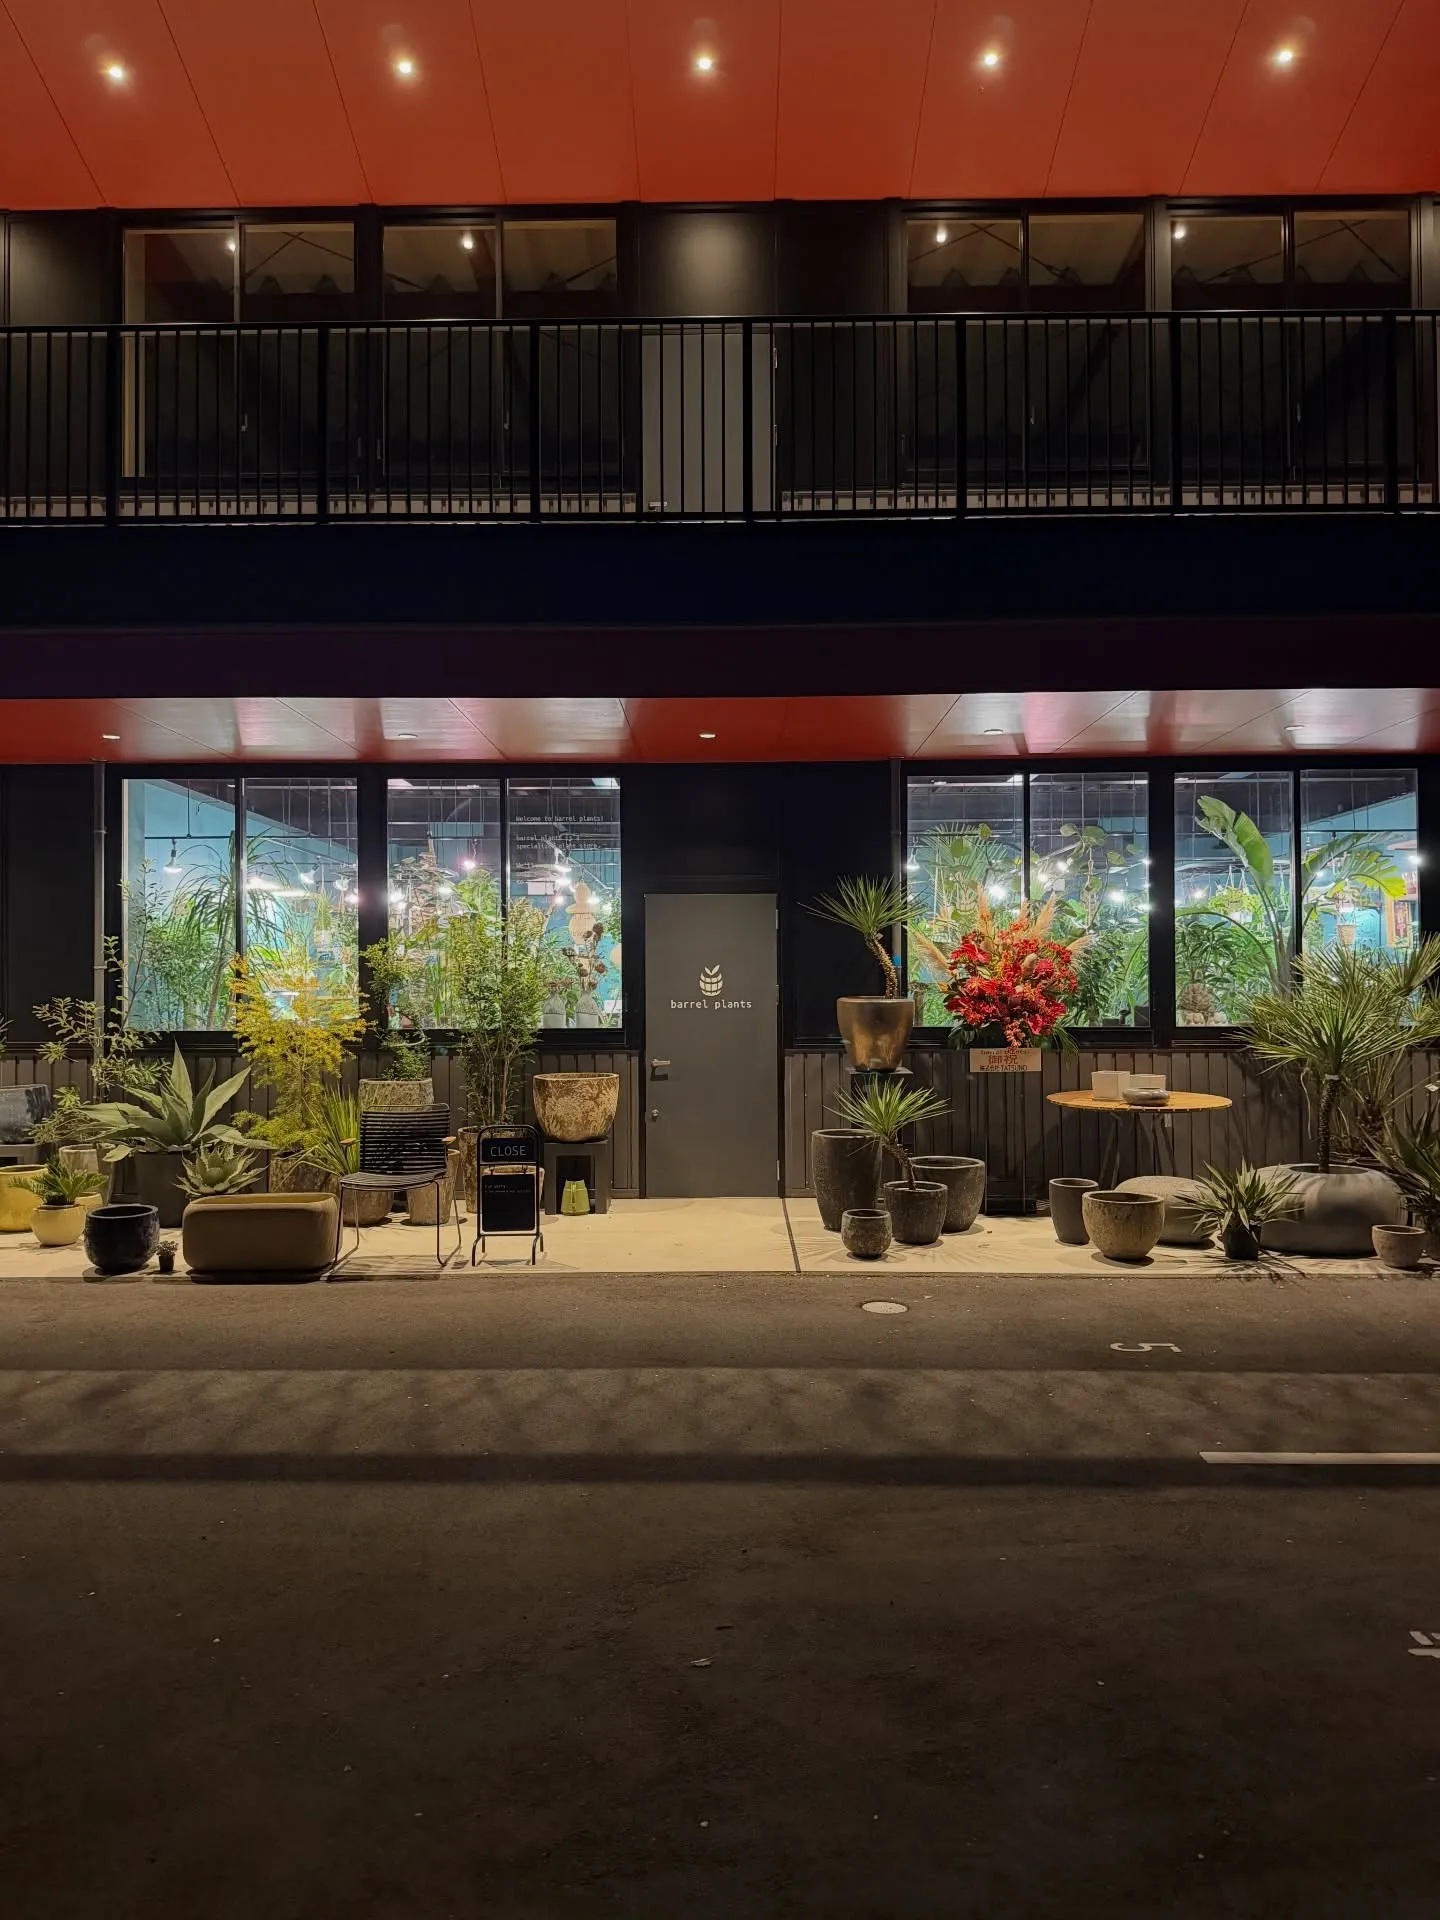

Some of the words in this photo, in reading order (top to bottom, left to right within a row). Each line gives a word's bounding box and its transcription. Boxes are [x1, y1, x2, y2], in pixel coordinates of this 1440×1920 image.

[579, 815, 604, 823] plants!
[670, 1000, 708, 1009] barrel
[714, 1000, 752, 1010] plants
[988, 1054, 1018, 1065] 御祝
[490, 1145, 528, 1157] CLOSE
[1109, 1342, 1183, 1353] 5
